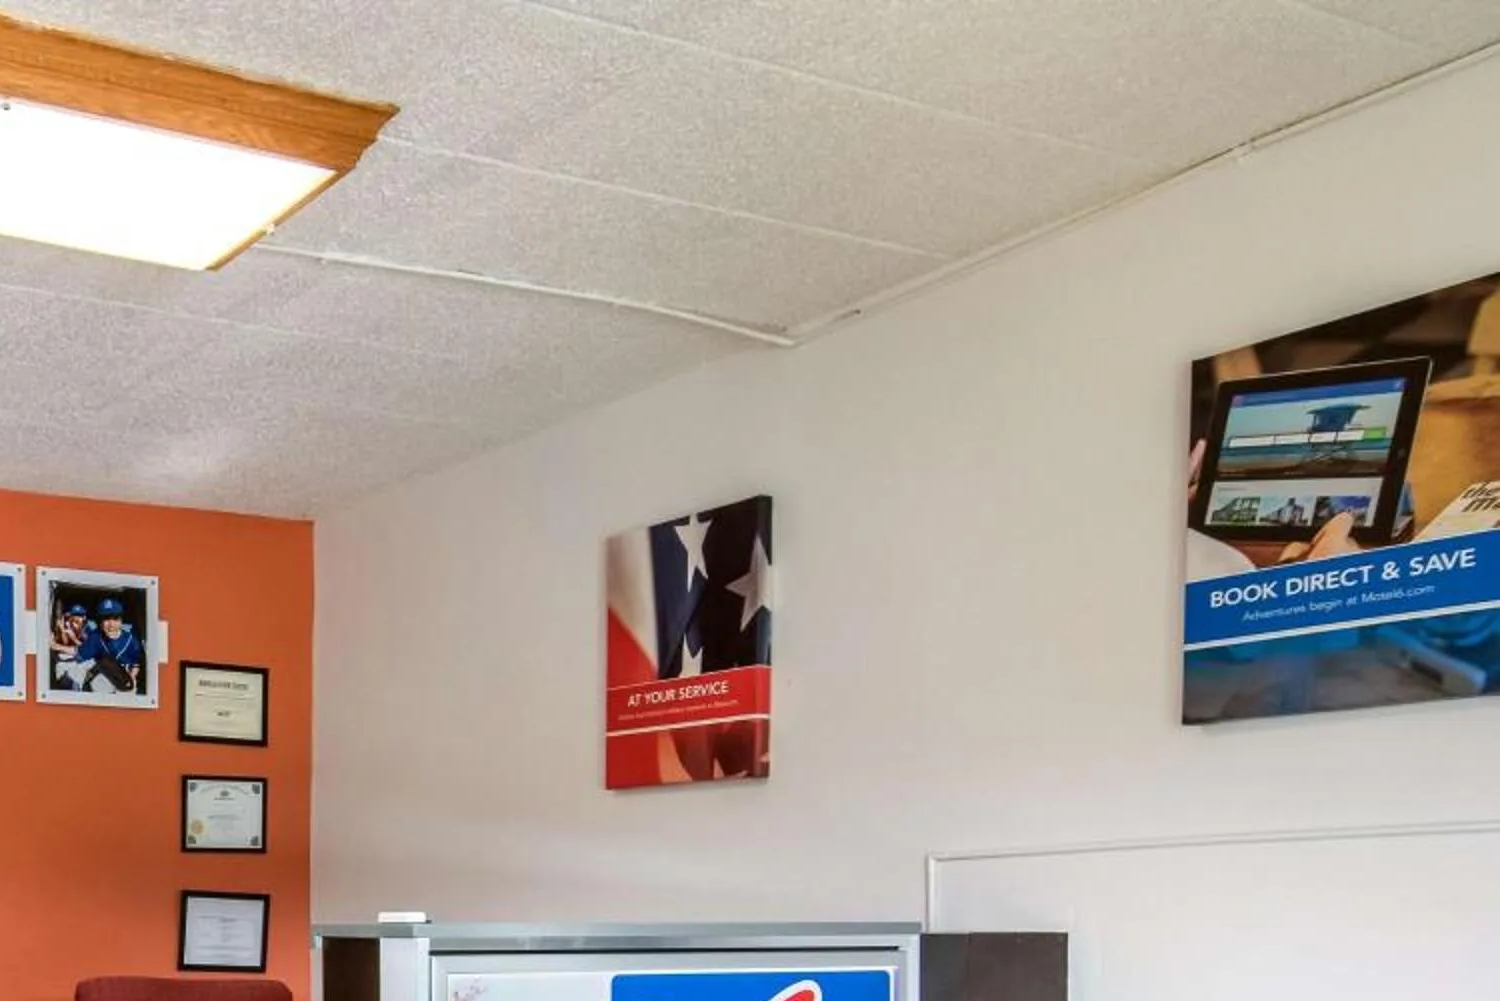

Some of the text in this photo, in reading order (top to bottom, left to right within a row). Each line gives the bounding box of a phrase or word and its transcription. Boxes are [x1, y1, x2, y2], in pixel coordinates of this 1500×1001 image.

[1209, 547, 1477, 609] BOOK DIRECT & SAVE
[1242, 604, 1306, 622] Adventures
[1309, 598, 1343, 614] begin
[1346, 596, 1358, 605] at
[627, 680, 729, 708] AT YOUR SERVICE
